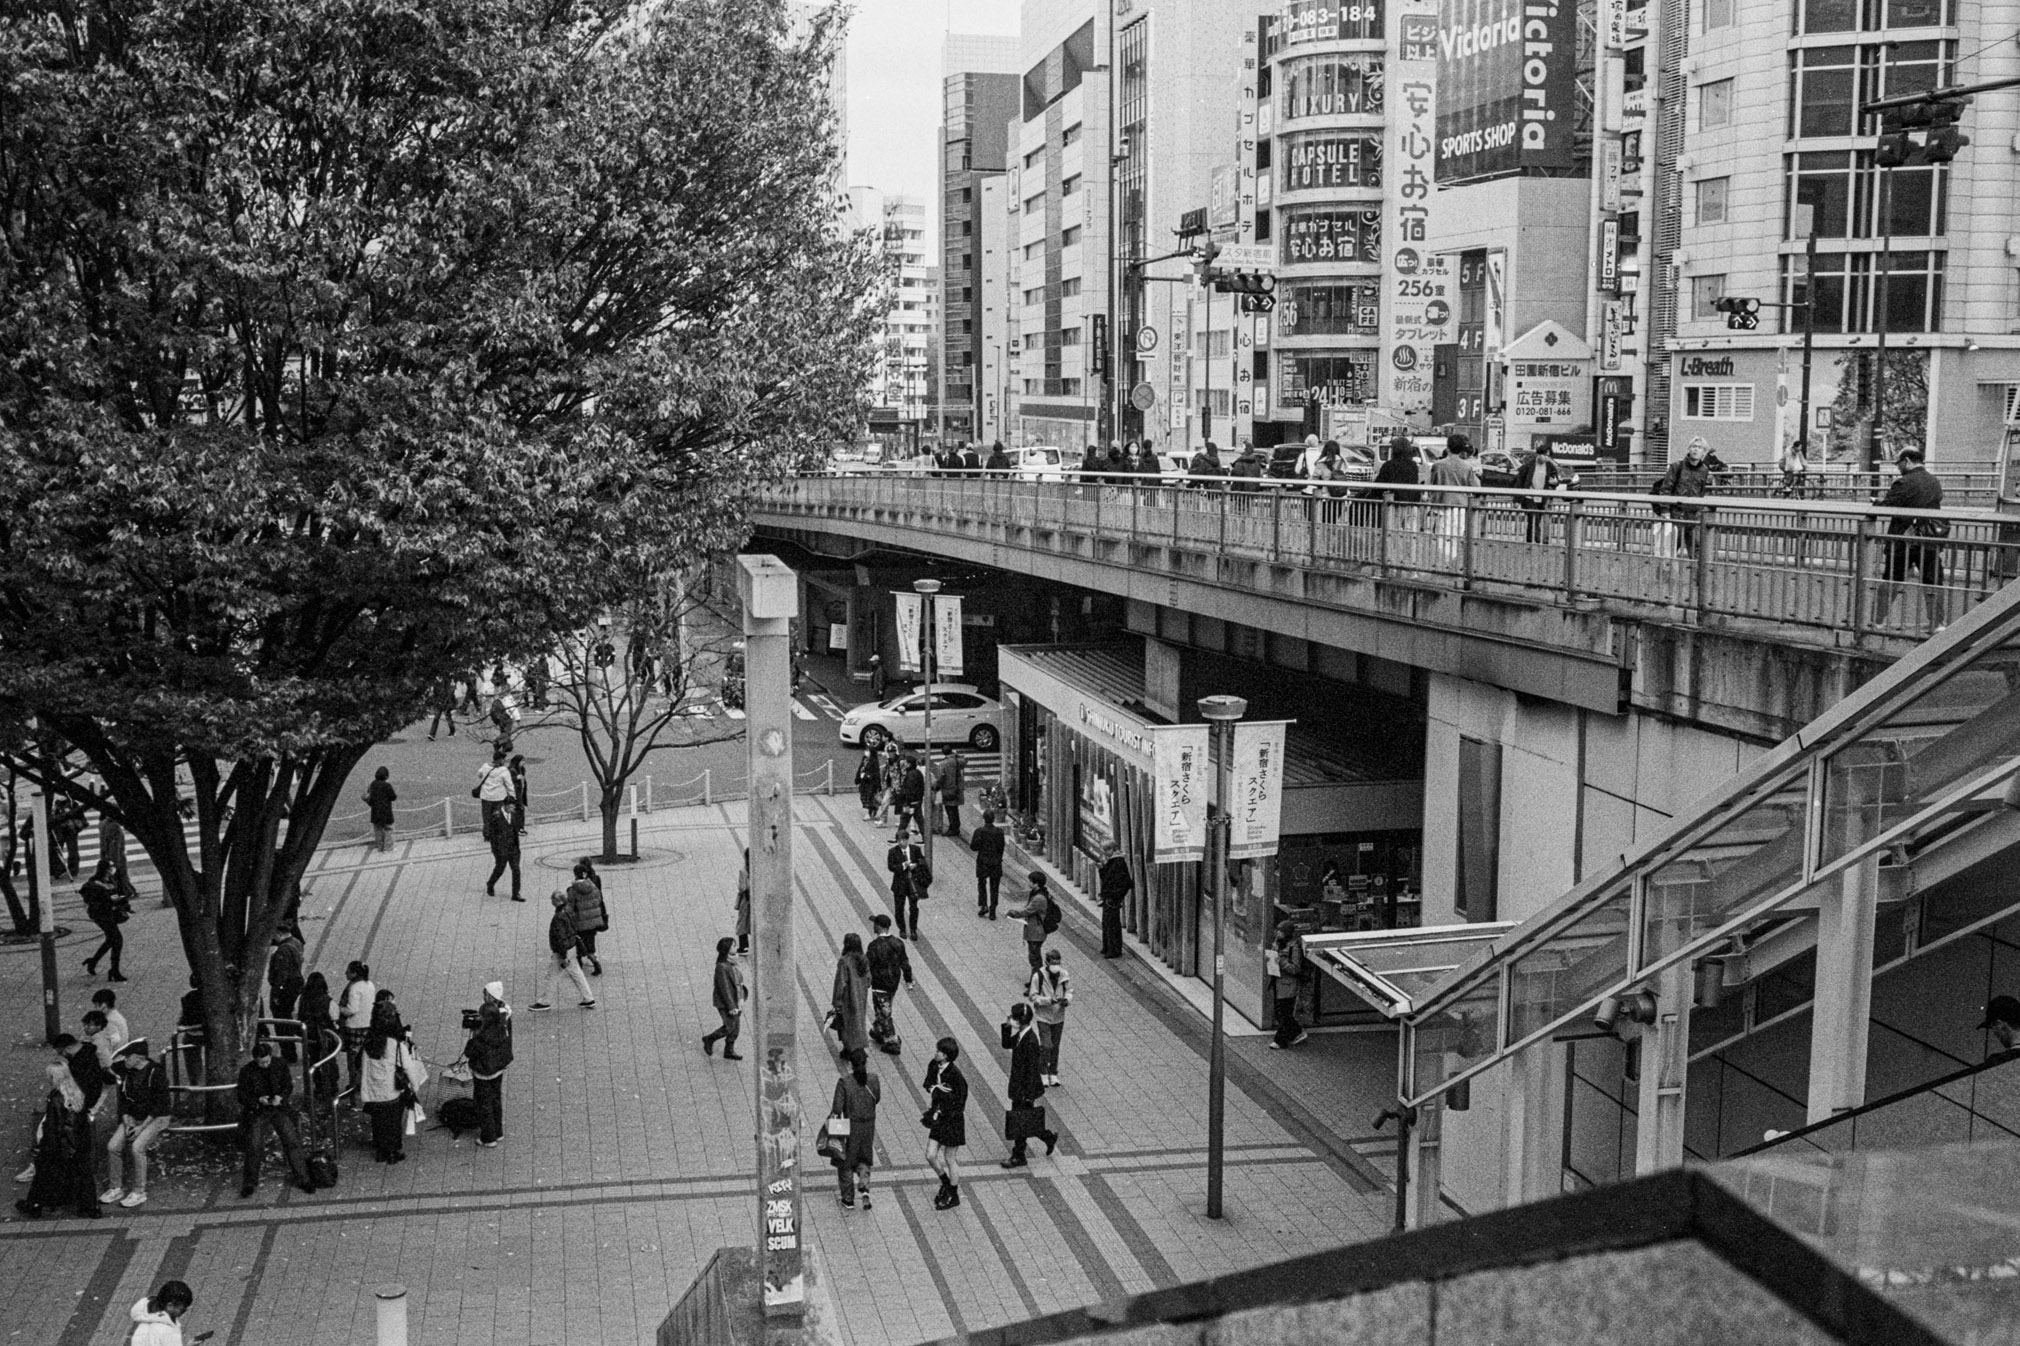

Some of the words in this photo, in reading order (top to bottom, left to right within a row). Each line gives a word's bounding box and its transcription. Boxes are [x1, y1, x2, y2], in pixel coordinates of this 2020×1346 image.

[1439, 8, 1521, 63] Victoria
[1522, 0, 1559, 150] ictoria
[1292, 92, 1359, 118] LUXURY
[1242, 30, 1256, 234] 豪華カプセルホテ
[1441, 129, 1483, 159] SPORTS
[1484, 121, 1516, 150] SHOP
[1291, 143, 1359, 167] CAPSULE
[1399, 80, 1433, 241] 安心お宿
[1291, 163, 1358, 187] HOTEL
[1220, 248, 1272, 259] スタ新宿前
[1289, 235, 1356, 260] 安心お宿
[1514, 363, 1581, 377] 田園新宿ビル
[1516, 390, 1572, 406] 広告募集
[1515, 407, 1572, 416] 0120-081-666
[1551, 441, 1595, 456] McDonald's
[1181, 744, 1194, 805] 「新宿さくら
[1258, 741, 1271, 801] 「新宿さくら
[1169, 780, 1181, 827] スクエア」
[1245, 776, 1258, 823] スクエア」
[767, 1199, 793, 1214] ZMSK
[767, 1218, 795, 1234] VELK
[767, 1235, 797, 1251] SCUM
